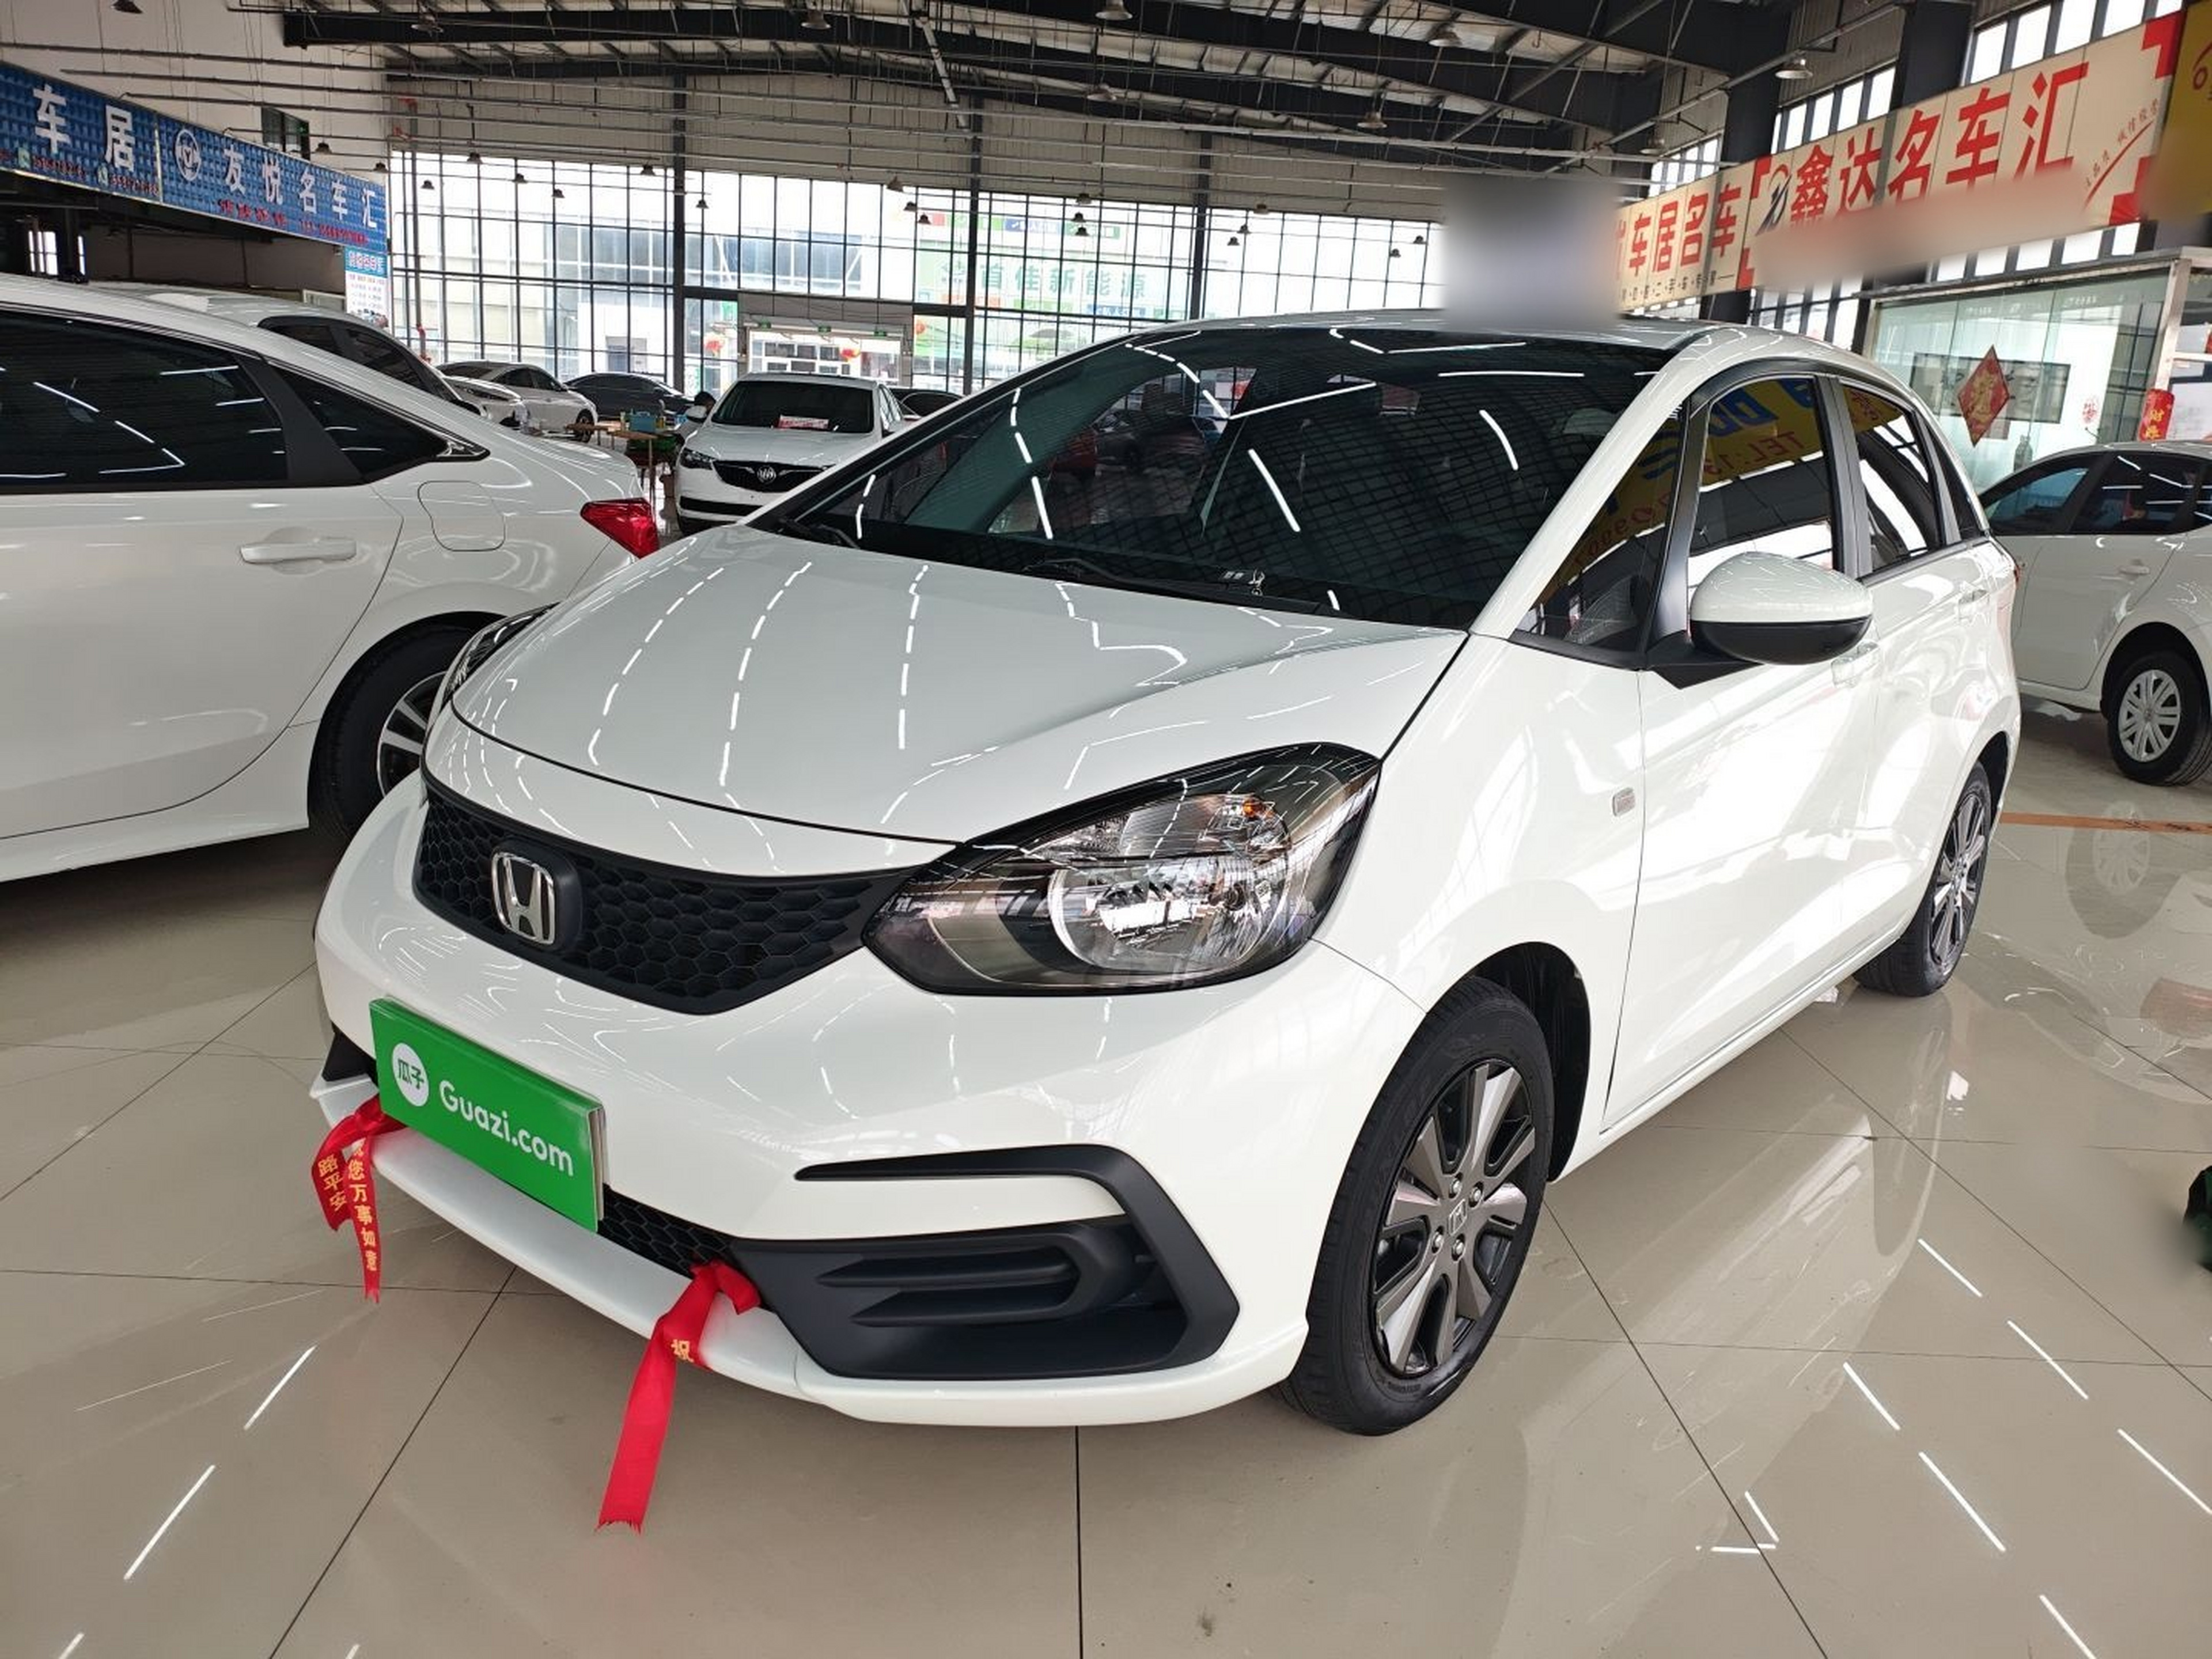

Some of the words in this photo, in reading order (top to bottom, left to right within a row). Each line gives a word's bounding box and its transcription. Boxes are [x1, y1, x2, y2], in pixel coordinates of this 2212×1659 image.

[33, 84, 136, 172] 车居
[1789, 62, 2089, 224] 鑫达名车汇
[223, 144, 377, 228] 友悦名车汇
[397, 1059, 425, 1090] 瓜子
[439, 1080, 573, 1177] Guazi.com
